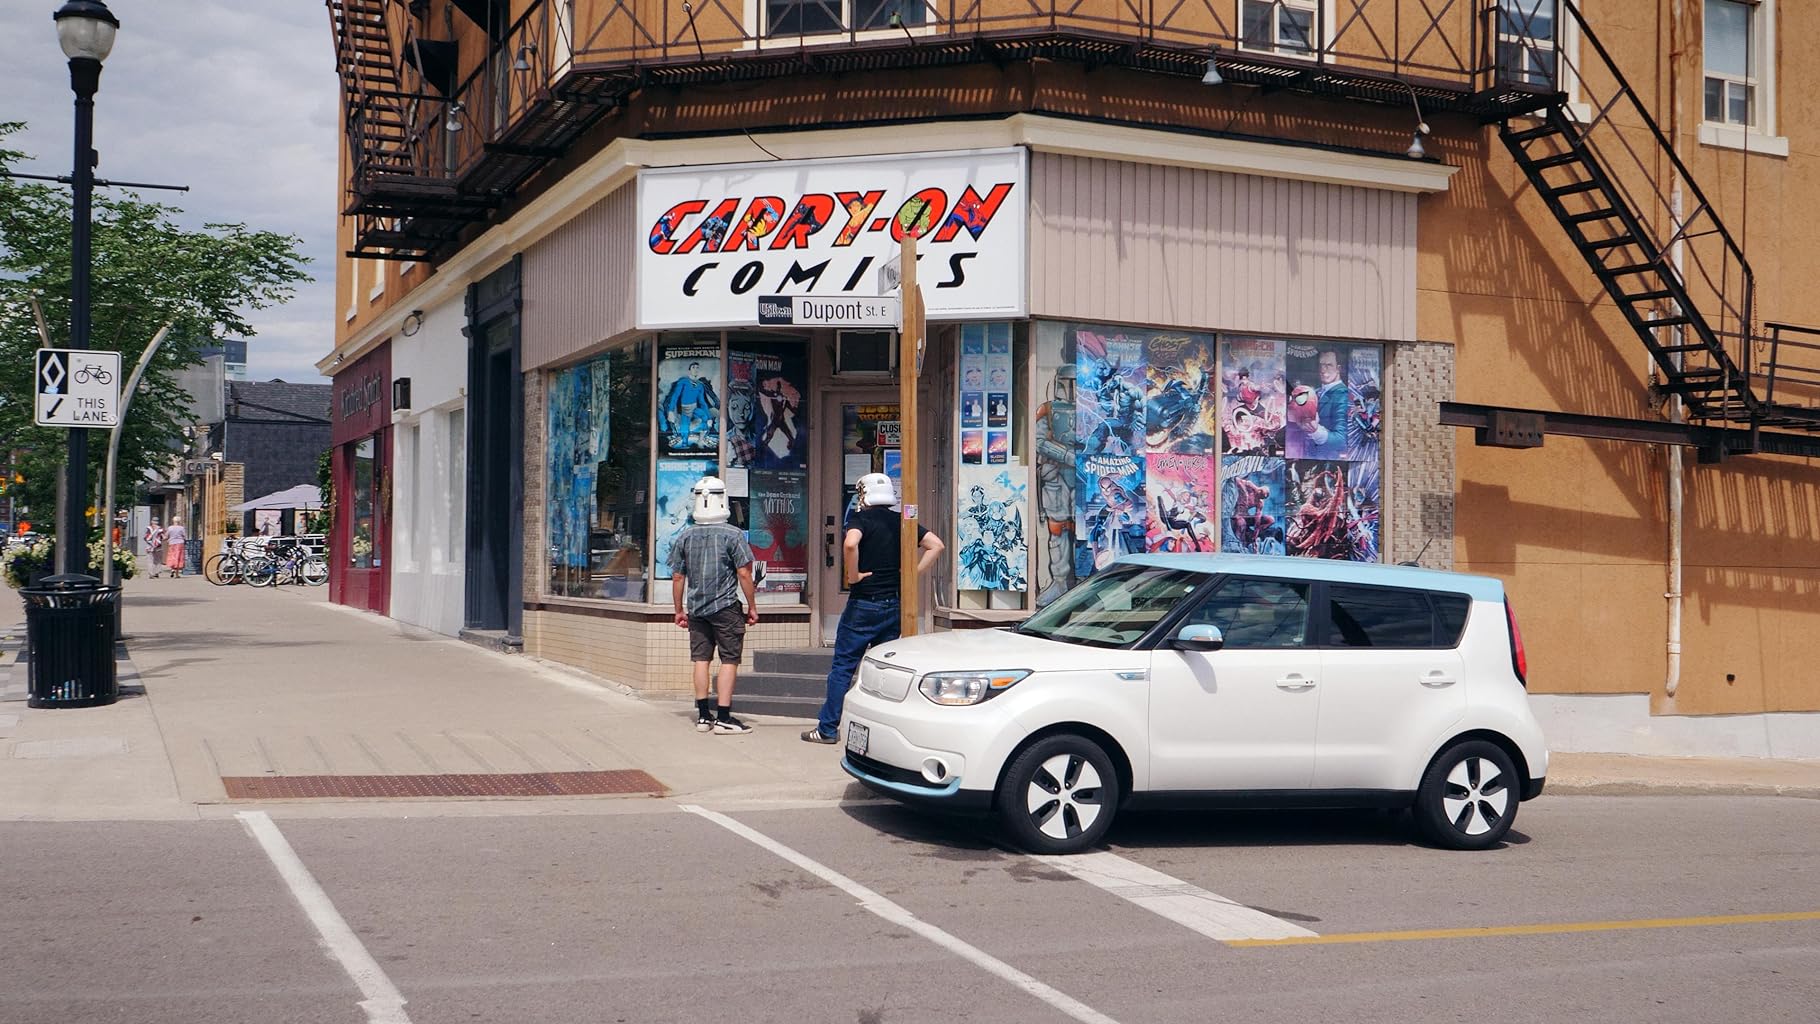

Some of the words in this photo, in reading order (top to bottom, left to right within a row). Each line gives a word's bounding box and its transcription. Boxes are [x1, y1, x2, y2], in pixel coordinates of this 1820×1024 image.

[648, 182, 1015, 256] CARRY-ON
[682, 252, 977, 297] COMIS
[803, 301, 862, 323] Dupont
[866, 306, 878, 317] St.
[881, 306, 887, 317] E
[77, 397, 105, 409] THIS
[73, 410, 108, 422] LANE
[1098, 456, 1132, 465] AMAZING
[1221, 455, 1265, 481] DAREDEVIL
[1084, 461, 1140, 477] SPIDER-MAN
[763, 498, 795, 514] MYTHOS
